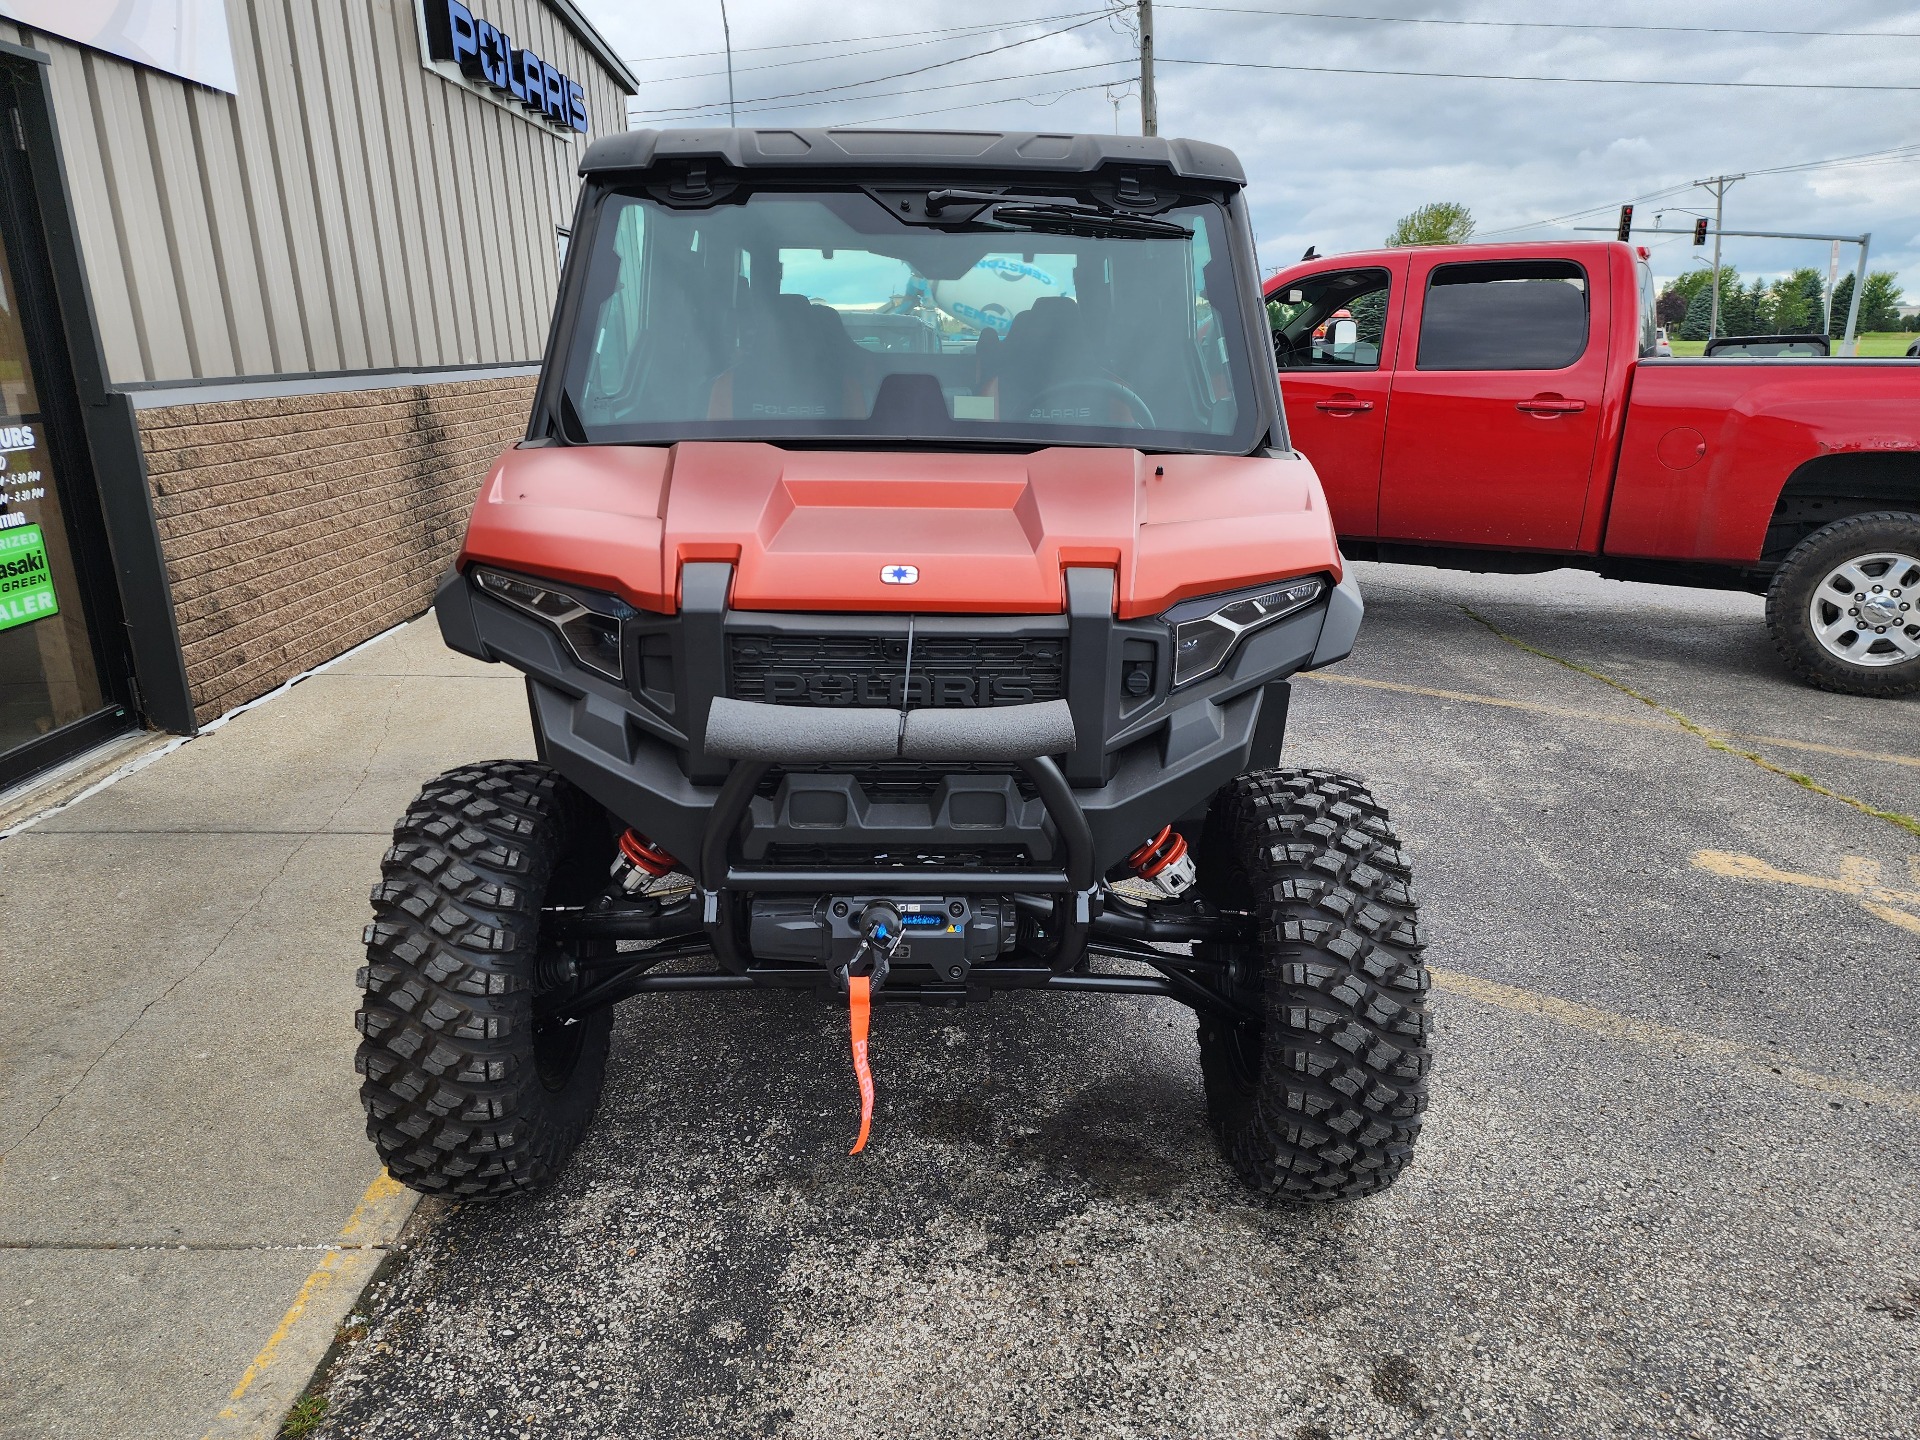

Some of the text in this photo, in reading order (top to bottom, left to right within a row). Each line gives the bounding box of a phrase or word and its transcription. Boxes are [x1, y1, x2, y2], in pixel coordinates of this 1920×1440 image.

[448, 0, 589, 134] POLARIS
[975, 259, 1052, 285] CEMSTON
[752, 403, 825, 416] POLARIS
[0, 425, 36, 448] URS
[28, 471, 41, 482] PM
[31, 487, 45, 499] PM
[0, 532, 39, 551] RIZED
[0, 550, 45, 580] asaki
[1, 573, 47, 593] GREEN
[0, 592, 54, 623] ALER
[763, 672, 1034, 706] POLARIS
[854, 1039, 874, 1121] POLARIS
